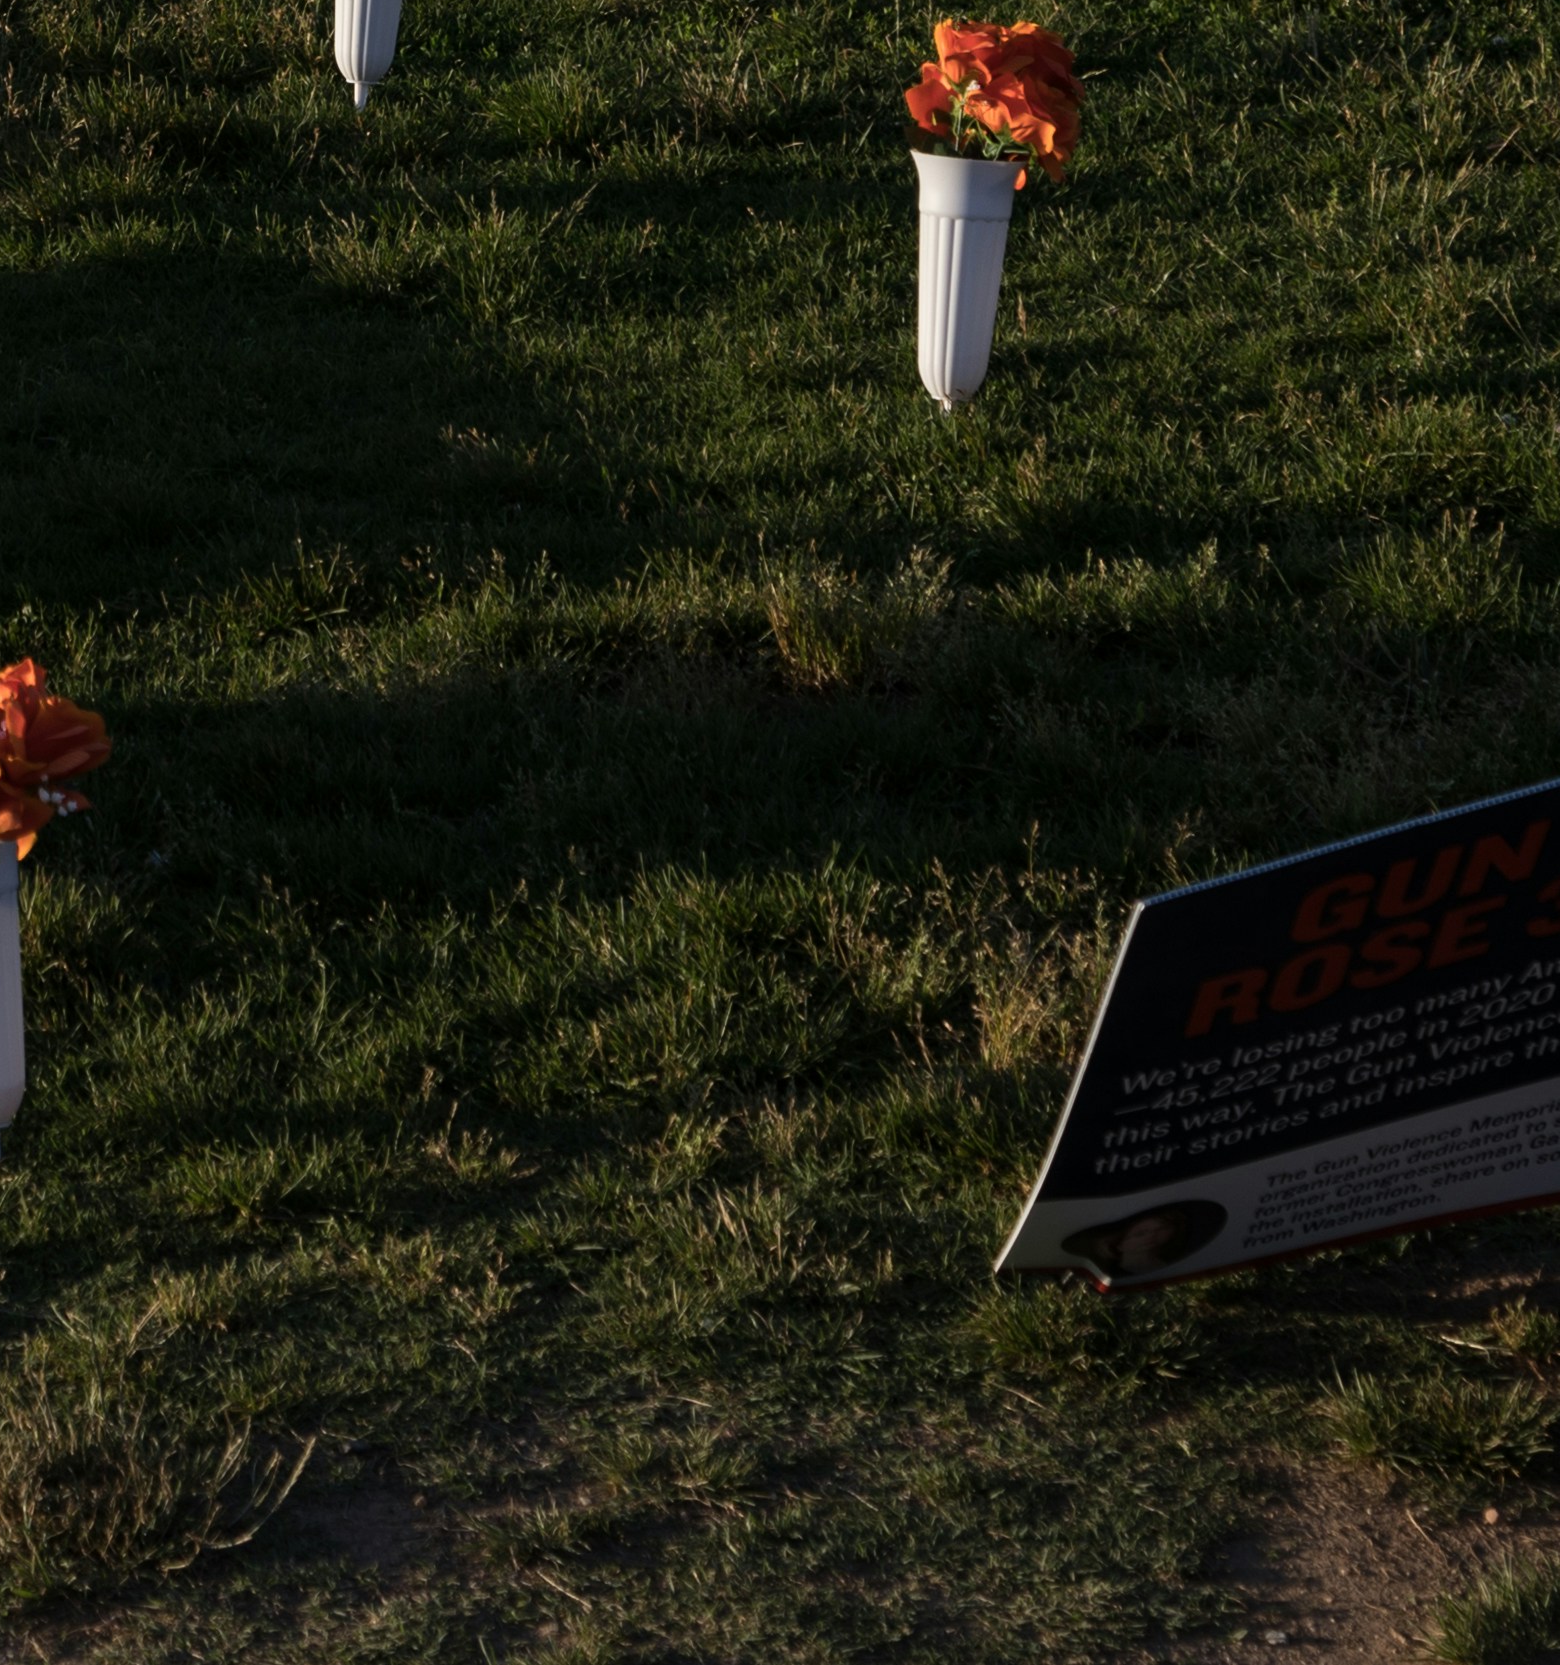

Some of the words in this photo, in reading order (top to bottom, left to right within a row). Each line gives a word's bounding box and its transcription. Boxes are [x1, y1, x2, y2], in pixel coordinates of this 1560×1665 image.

[1292, 819, 1551, 944] GUN
[1184, 896, 1510, 1039] ROSE
[1122, 1057, 1222, 1095] We're
[1231, 1022, 1342, 1068] losing
[1349, 1005, 1406, 1034] too
[1414, 974, 1513, 1015] many
[1286, 1030, 1408, 1081] people
[1415, 1017, 1449, 1040] in
[1457, 981, 1556, 1028] 2020
[1094, 1143, 1180, 1175] their
[1187, 1109, 1310, 1155] stories
[1317, 1081, 1387, 1119] and
[1393, 1049, 1514, 1097] inspire
[1103, 1121, 1171, 1148] this
[1180, 1100, 1256, 1131] way.
[1274, 1075, 1336, 1106] The
[1345, 1052, 1417, 1085] Gun
[1247, 1216, 1284, 1234] the
[1290, 1183, 1422, 1223] installation,
[1430, 1164, 1495, 1188] share
[1500, 1157, 1529, 1172] on
[1253, 1191, 1330, 1219] former
[1335, 1142, 1522, 1197] Congresswoman
[1259, 1158, 1400, 1204] organization
[1406, 1124, 1519, 1164] dedicated
[1525, 1120, 1547, 1134] to
[1266, 1169, 1307, 1187] The
[1313, 1154, 1358, 1175] Gun
[1366, 1126, 1462, 1159] Violence
[1242, 1228, 1294, 1249] from
[1301, 1193, 1440, 1234] Washington.
